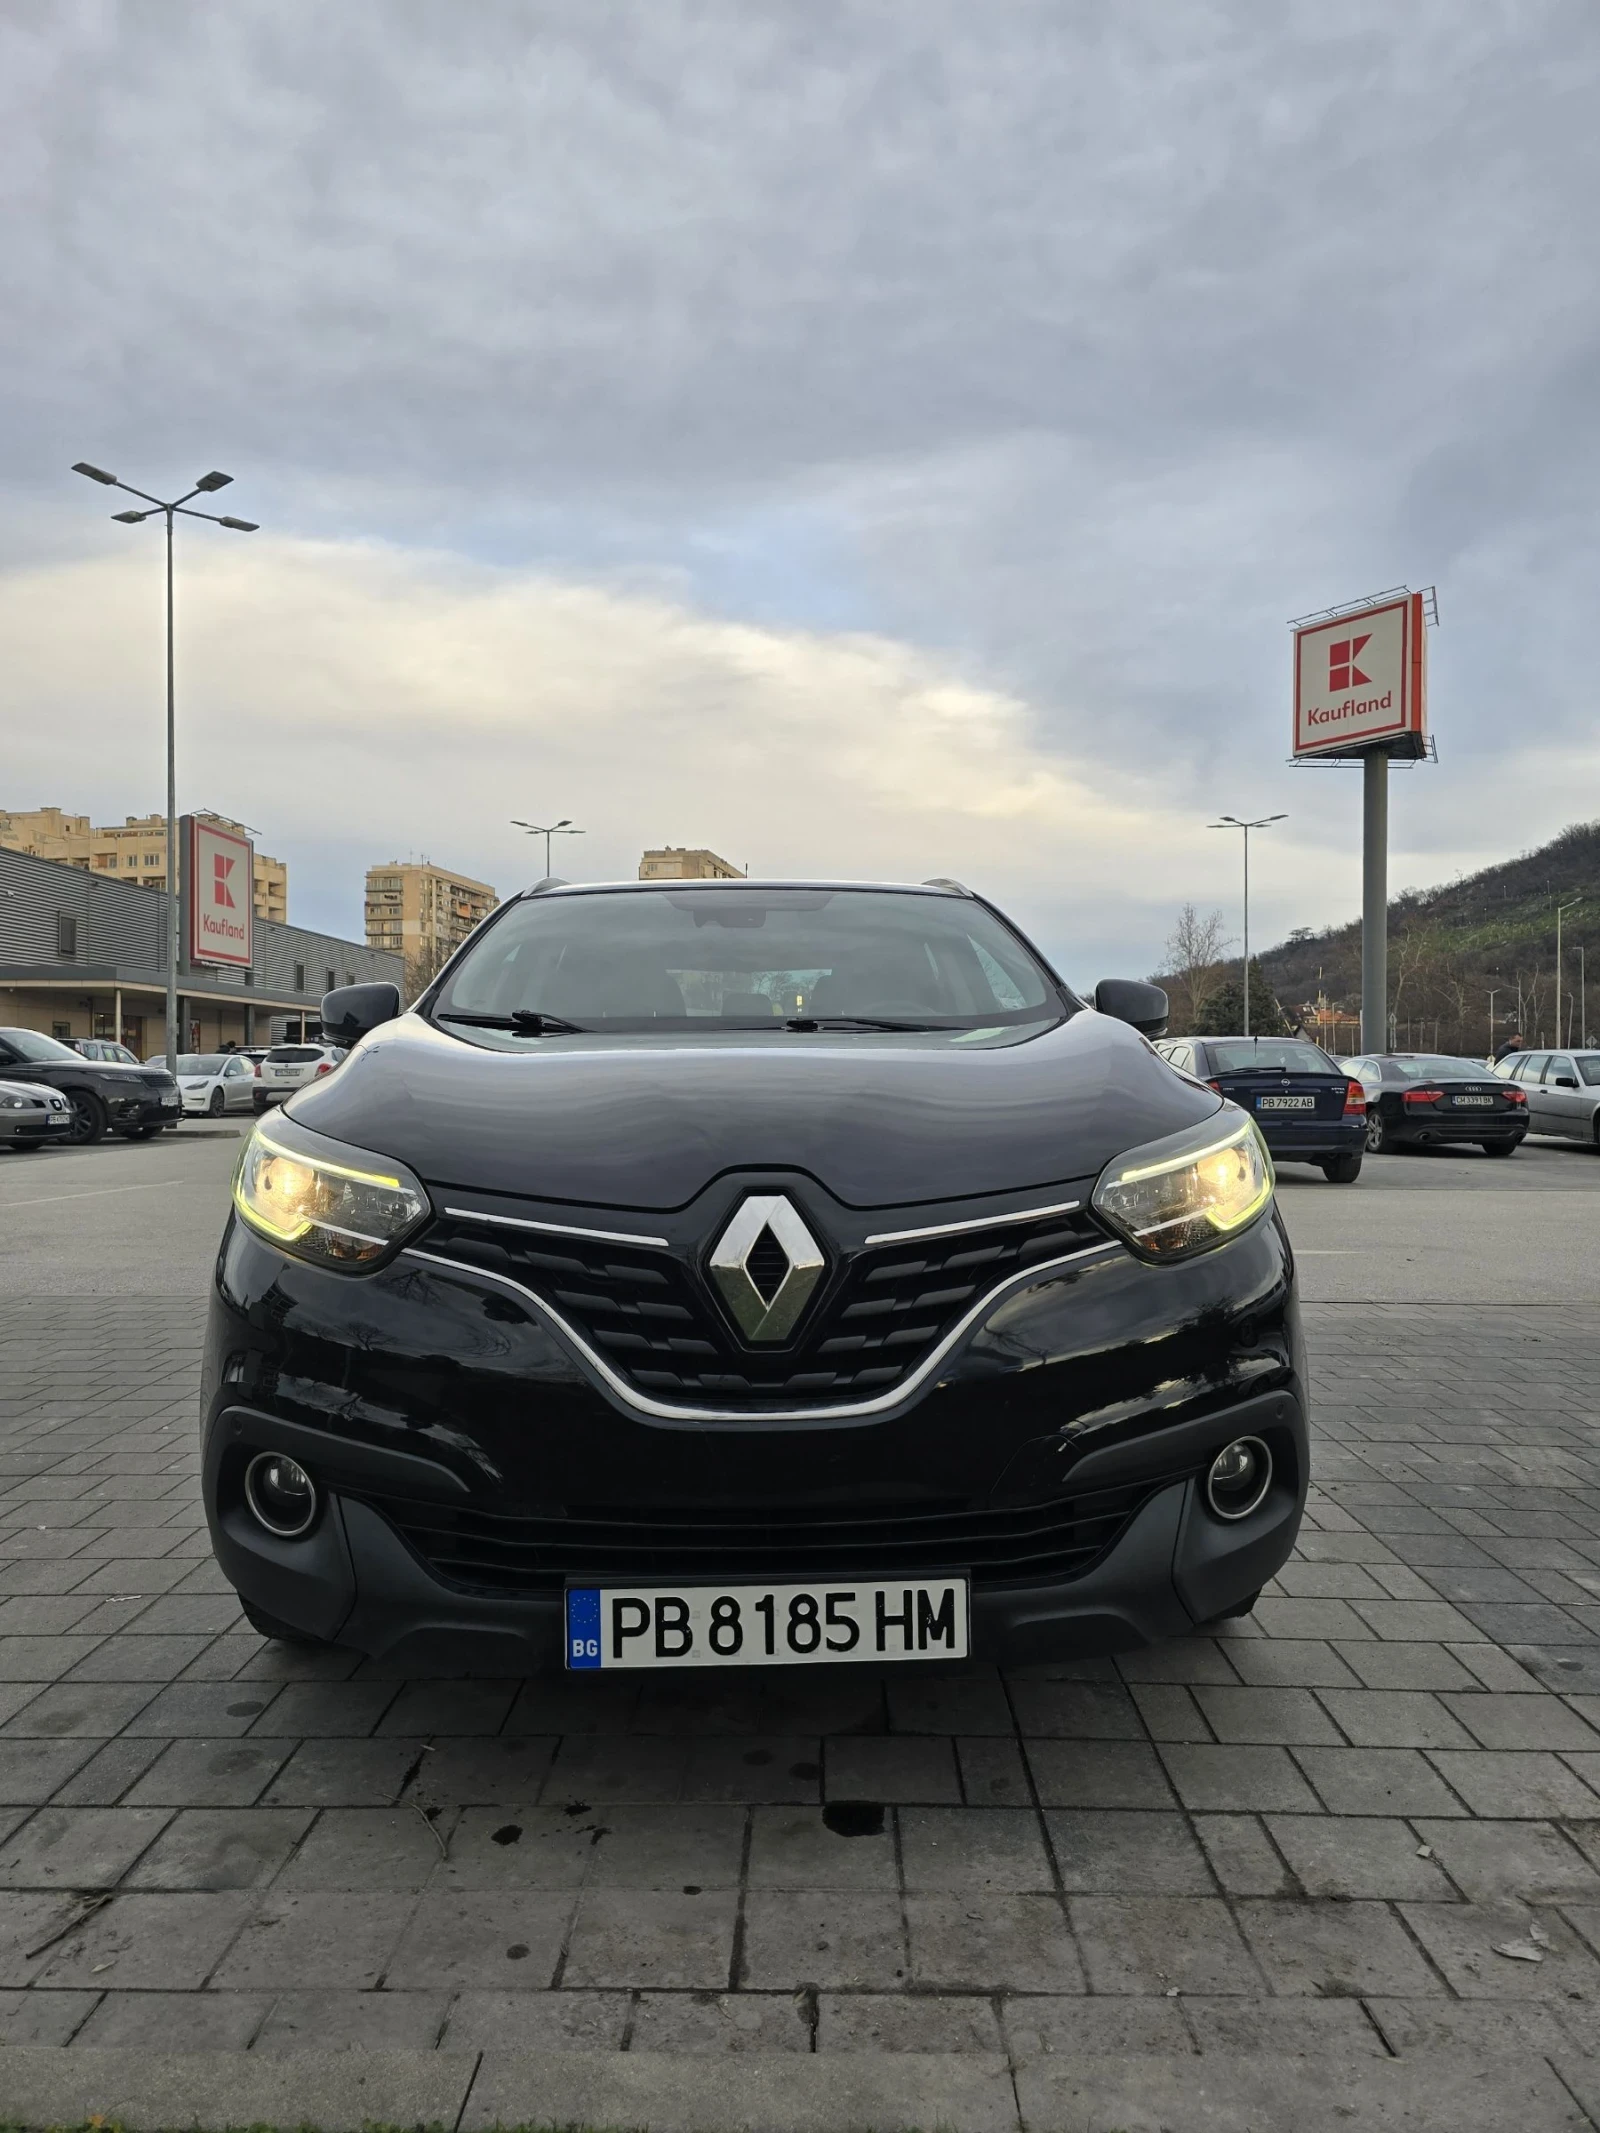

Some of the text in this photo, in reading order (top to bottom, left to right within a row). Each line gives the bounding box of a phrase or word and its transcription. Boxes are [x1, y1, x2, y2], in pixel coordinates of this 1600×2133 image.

[1308, 690, 1392, 726] Kaufland
[203, 914, 245, 940] Kaufland
[1262, 1098, 1313, 1108] PB 7922 AB
[612, 1588, 956, 1658] PB 8185 HM
[572, 1639, 598, 1657] BG
